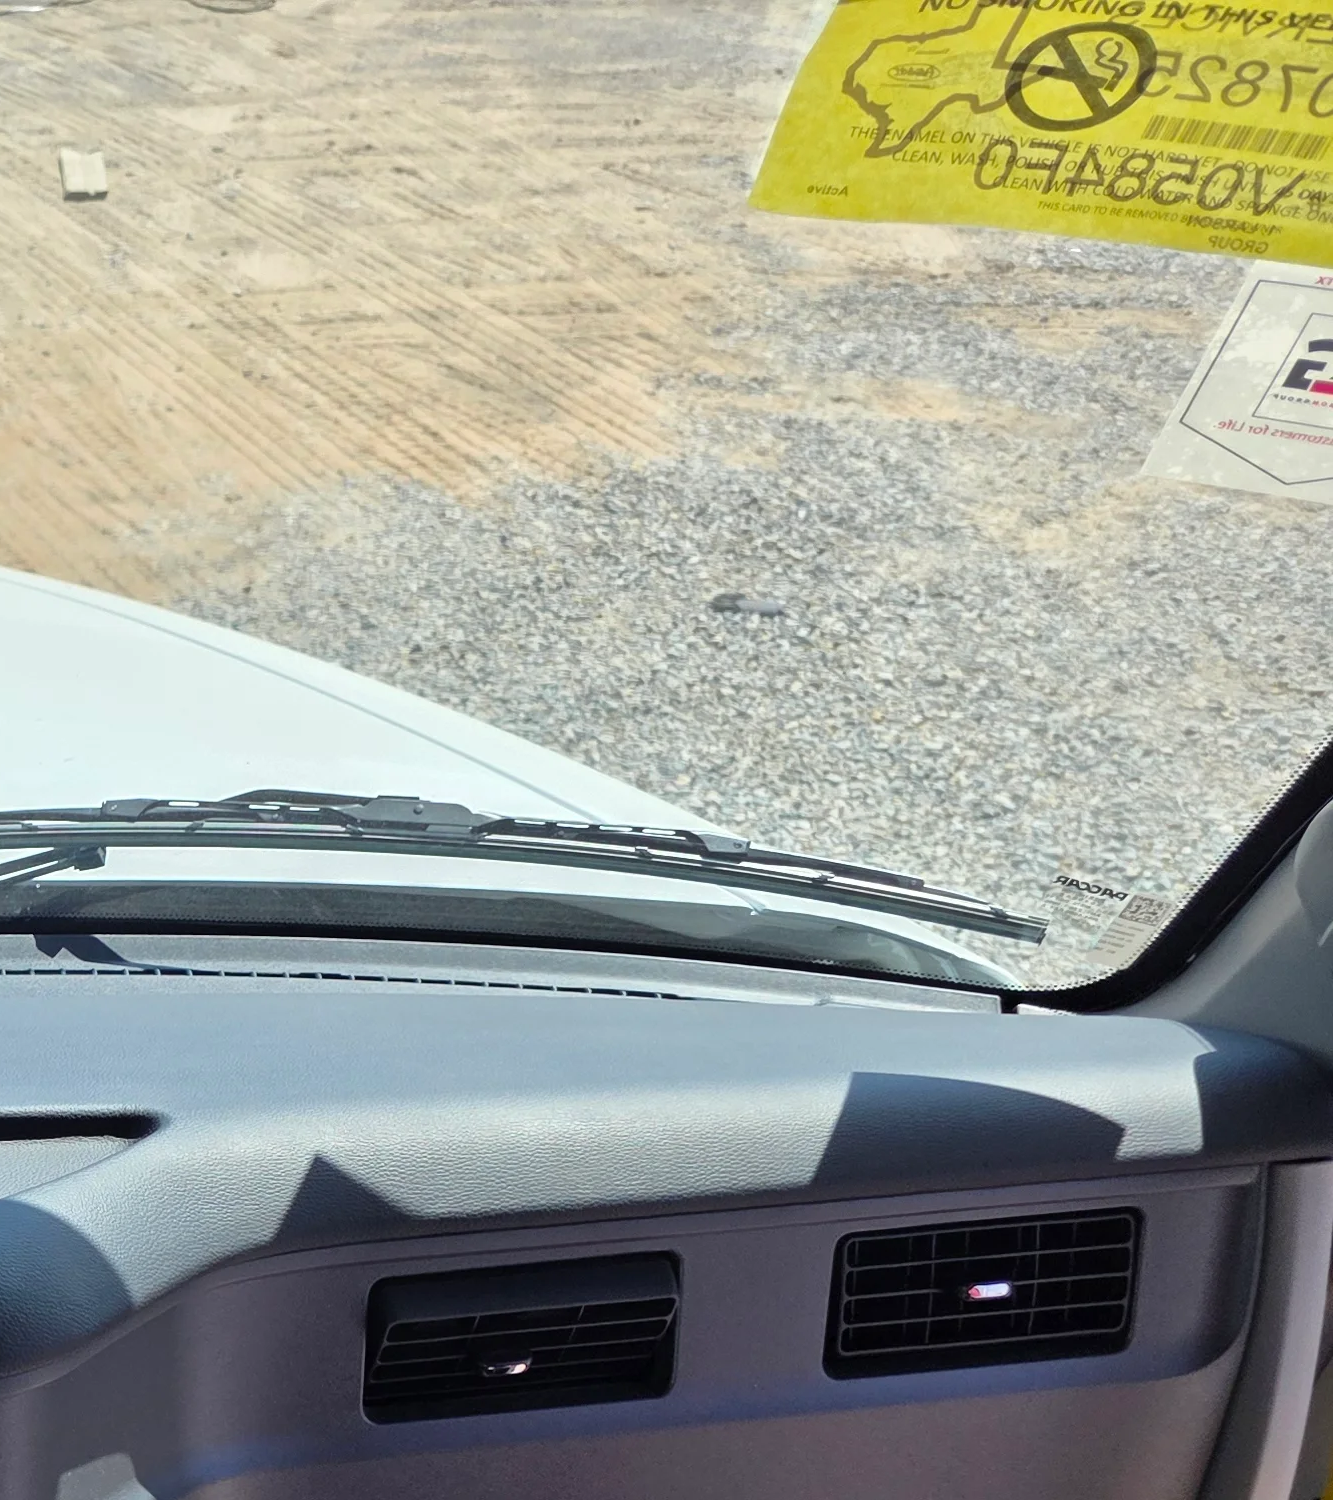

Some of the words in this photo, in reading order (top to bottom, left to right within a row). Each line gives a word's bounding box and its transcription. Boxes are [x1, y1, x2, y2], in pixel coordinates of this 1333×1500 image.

[919, 0, 970, 12] NO
[974, 0, 1145, 18] SMOKING
[1151, 0, 1193, 20] IN
[849, 126, 879, 140] THE
[884, 129, 947, 144] ENAMEL
[950, 131, 976, 145] ON
[1019, 136, 1083, 154] VEHICLE
[1104, 145, 1142, 159] NOT
[1263, 164, 1297, 179] NOT
[892, 150, 945, 167] CLEAN,
[993, 175, 1044, 191] CLEAN
[1093, 184, 1135, 199] COLD
[1037, 200, 1061, 212] THIS
[1062, 203, 1091, 215] CARD
[1093, 205, 1108, 216] TO
[1110, 207, 1125, 218] BE
[1125, 209, 1179, 222] REMOVED
